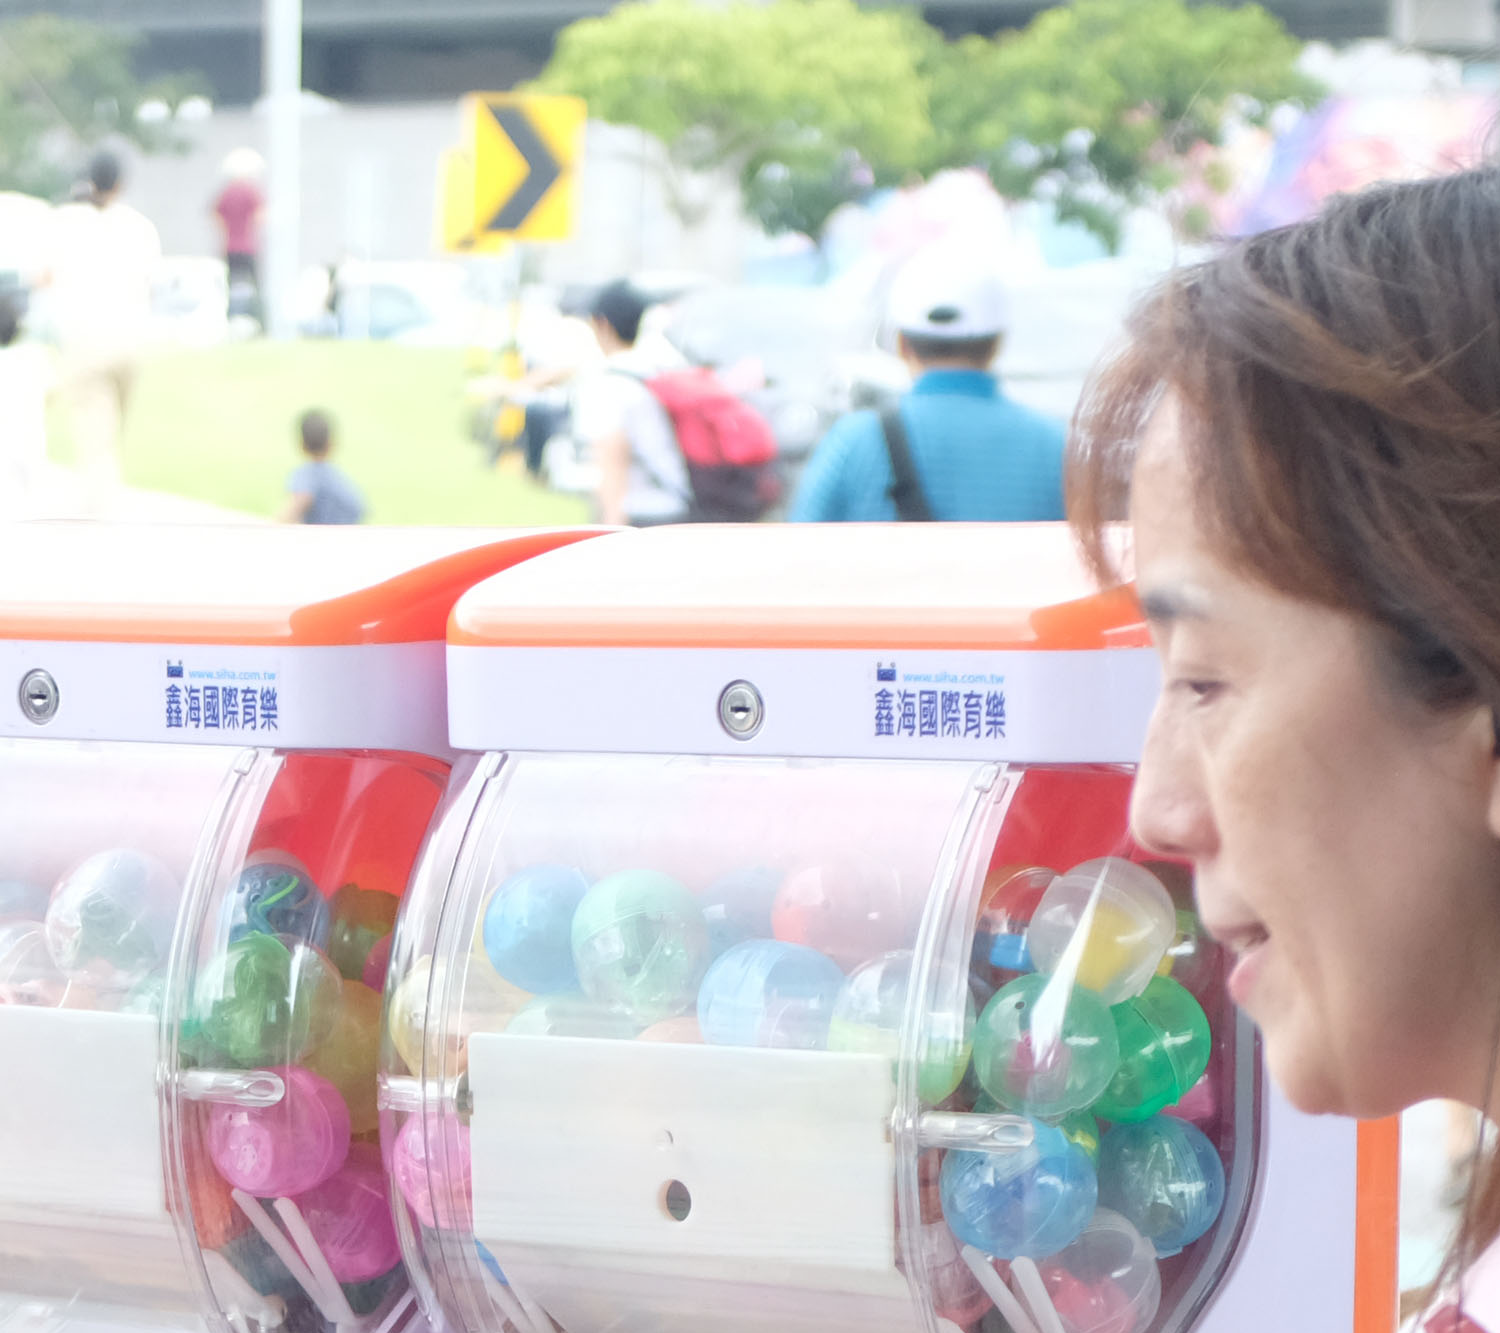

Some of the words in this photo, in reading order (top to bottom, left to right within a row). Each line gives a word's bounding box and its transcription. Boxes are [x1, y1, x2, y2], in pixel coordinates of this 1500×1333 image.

[165, 683, 279, 731] 鑫海國際育樂
[874, 688, 1006, 740] 鑫海國際育樂
